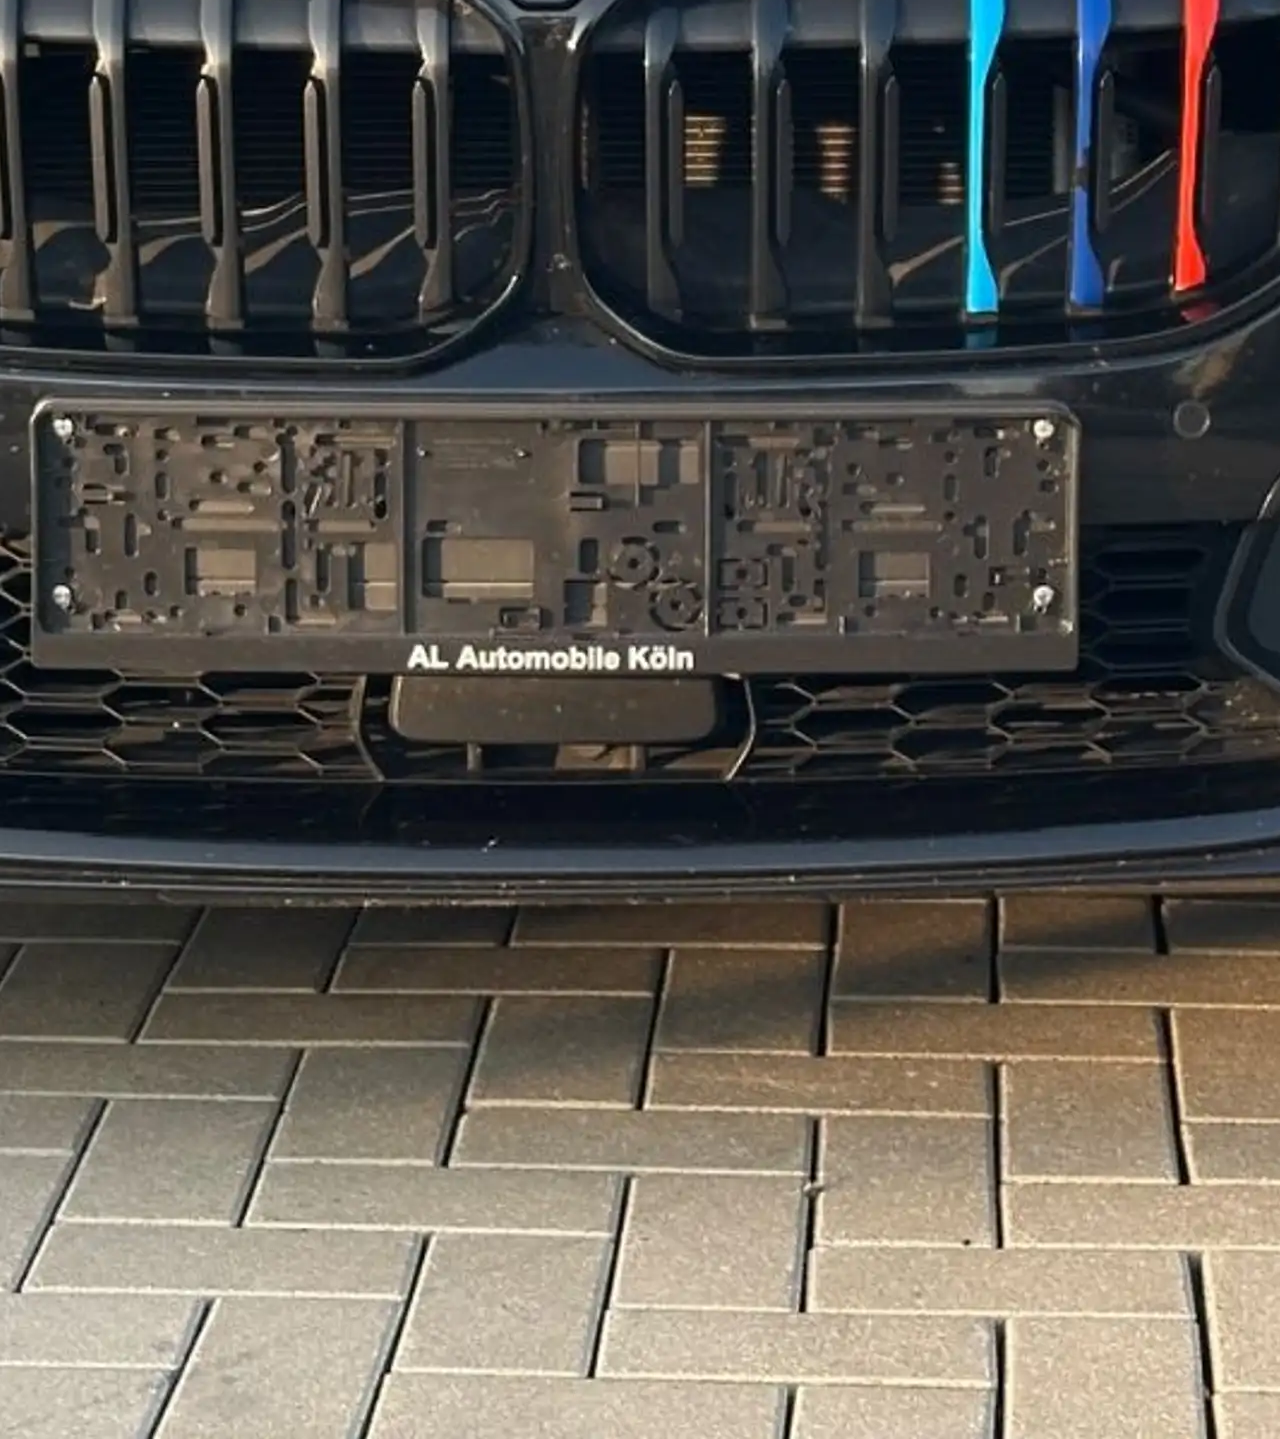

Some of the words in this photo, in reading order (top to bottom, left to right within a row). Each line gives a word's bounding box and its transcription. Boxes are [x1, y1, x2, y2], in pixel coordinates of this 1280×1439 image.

[407, 645, 448, 669] AL
[456, 645, 620, 670] Automobile
[628, 646, 694, 670] Köln
